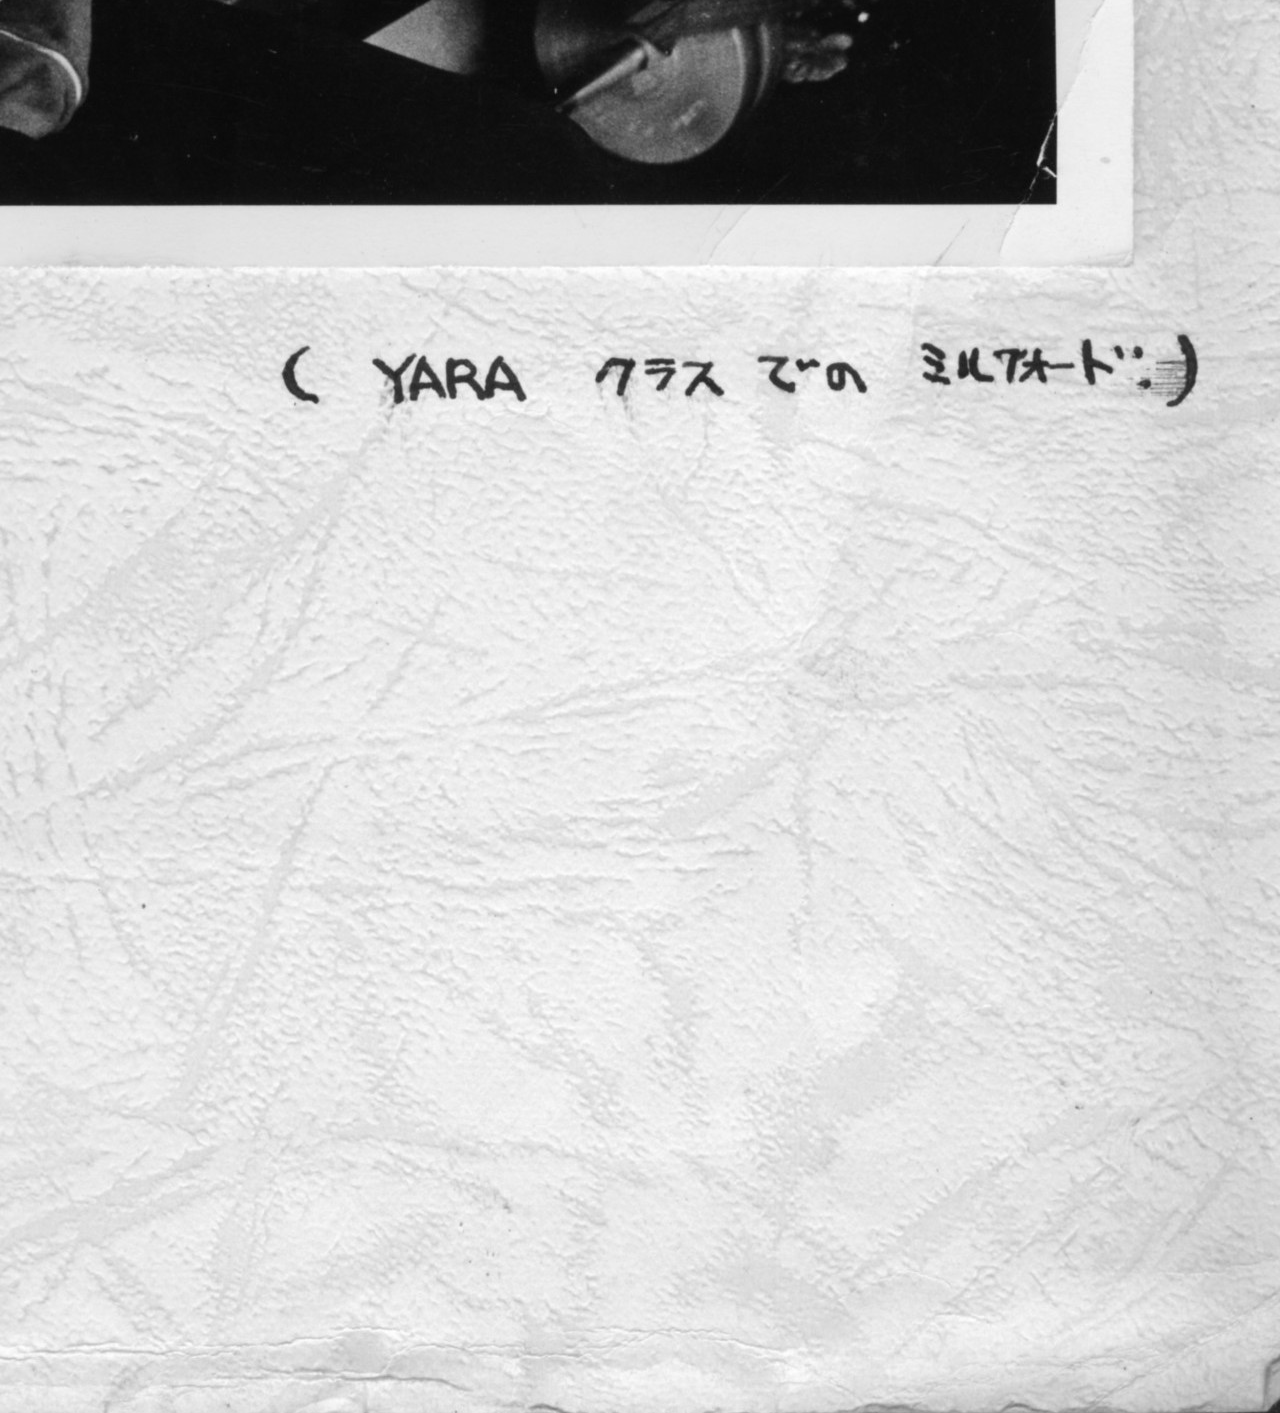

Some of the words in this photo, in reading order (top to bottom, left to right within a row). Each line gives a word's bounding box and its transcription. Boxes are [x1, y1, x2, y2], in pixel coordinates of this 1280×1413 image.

[372, 353, 527, 404] YARA
[595, 357, 725, 397] クラス
[757, 355, 867, 393] での
